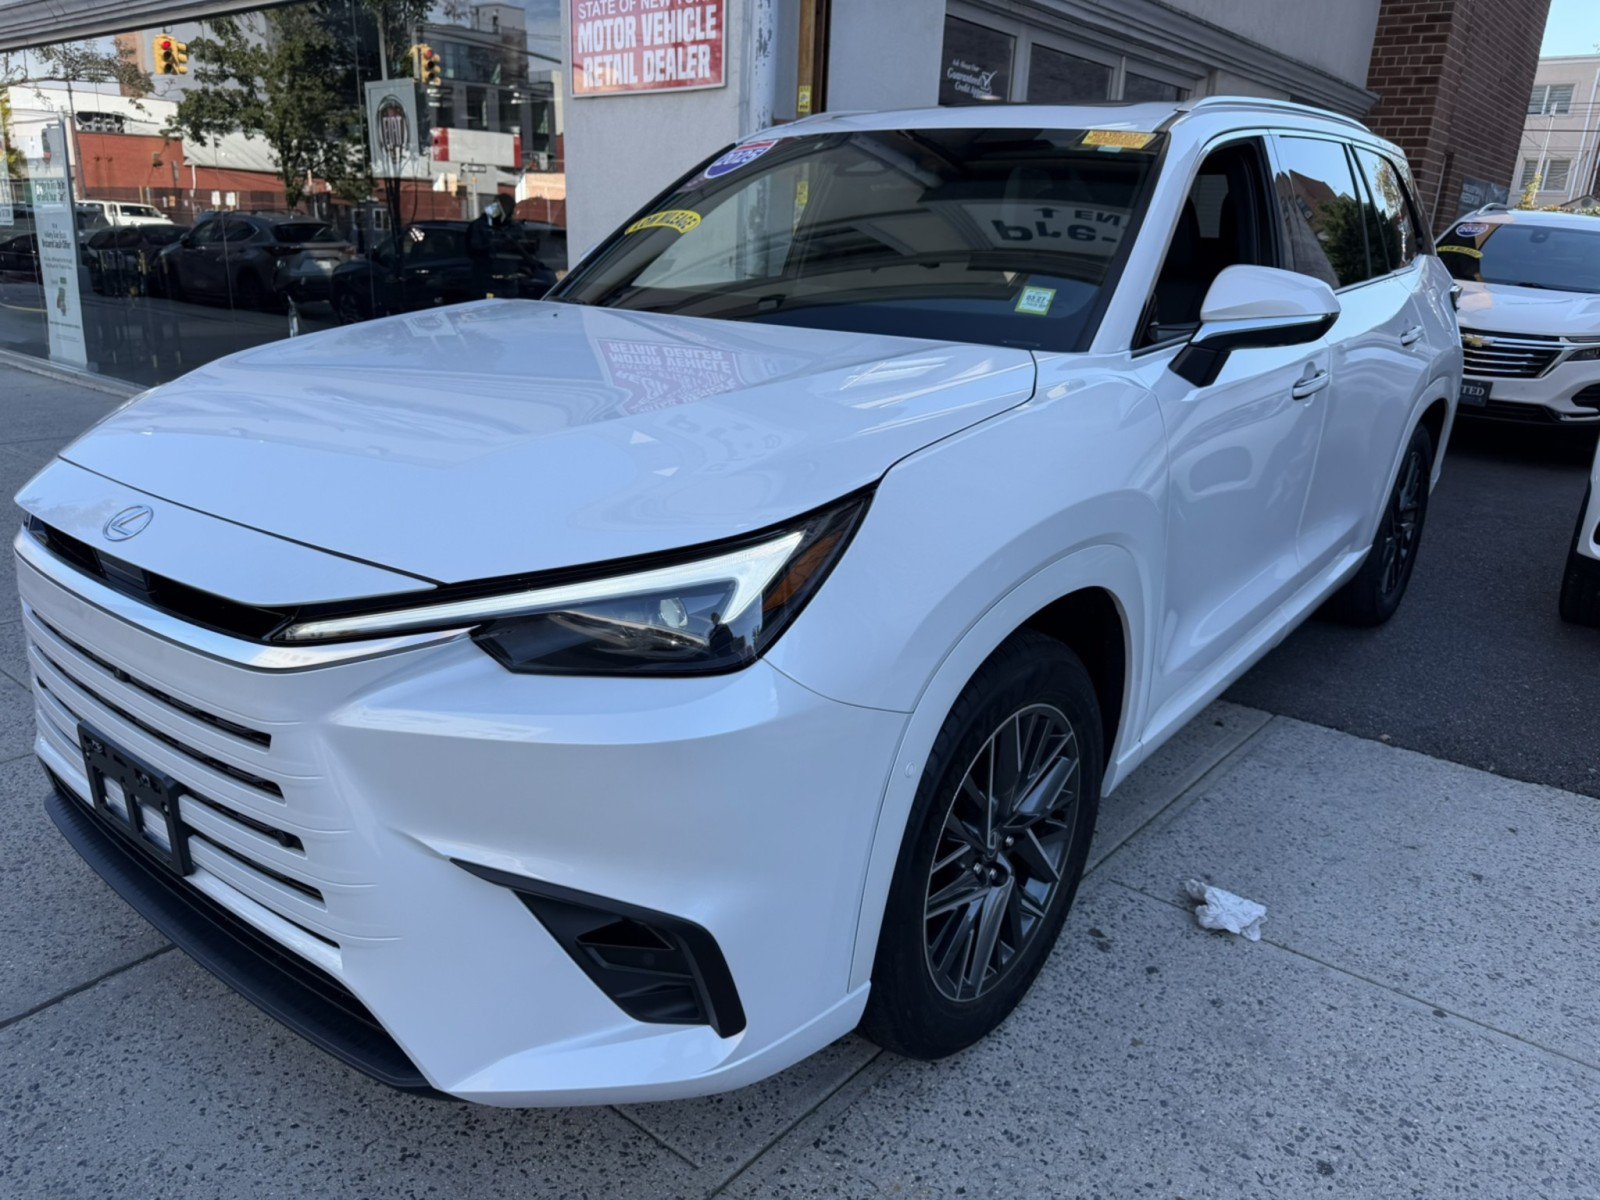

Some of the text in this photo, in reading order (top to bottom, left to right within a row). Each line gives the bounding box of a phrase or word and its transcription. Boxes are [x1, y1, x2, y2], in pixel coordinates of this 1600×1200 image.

[578, 0, 616, 19] STATE
[619, 0, 637, 13] OF
[578, 4, 717, 54] MOTOR VEHICLE
[583, 44, 711, 88] RETAIL DEALER
[382, 115, 402, 149] FIAT
